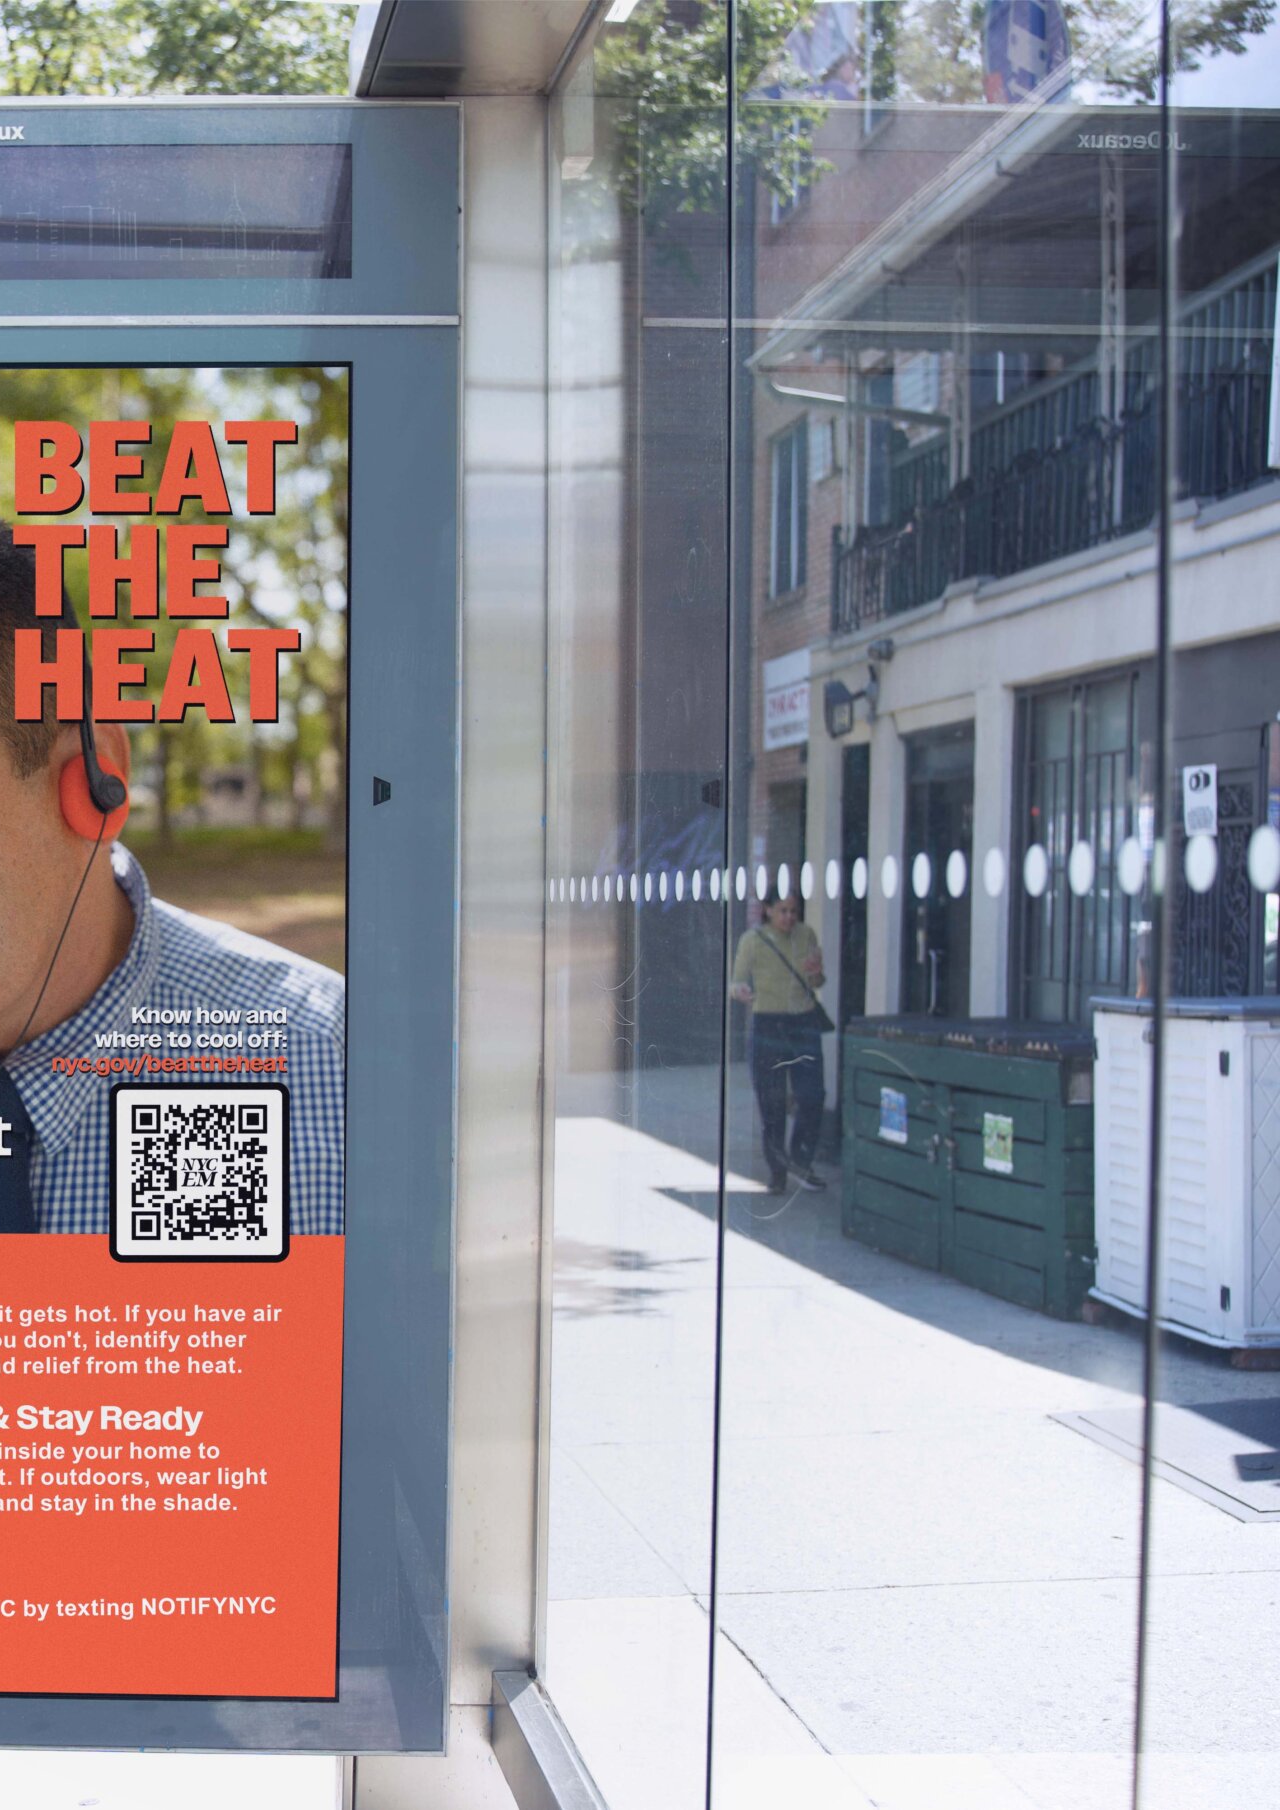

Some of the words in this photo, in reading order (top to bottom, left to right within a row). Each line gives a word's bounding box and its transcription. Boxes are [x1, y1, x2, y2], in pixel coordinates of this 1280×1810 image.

[14, 421, 298, 515] BEAT
[12, 525, 229, 619] THE
[14, 629, 301, 723] HEAT
[131, 1006, 192, 1025] Know
[196, 1006, 241, 1025] how
[246, 1006, 287, 1025] and
[95, 1031, 162, 1049] where
[167, 1031, 191, 1049] to
[196, 1031, 242, 1049] cool
[248, 1031, 288, 1049] off:
[52, 1054, 288, 1076] nyc.gov/beattheheat
[181, 1157, 218, 1172] NYC
[181, 1172, 218, 1187] EM
[19, 1305, 68, 1327] gets
[75, 1304, 117, 1323] hot.
[125, 1304, 140, 1322] If
[145, 1308, 186, 1327] you
[194, 1304, 246, 1322] have
[253, 1304, 282, 1322] air
[23, 1330, 88, 1351] don't,
[95, 1330, 181, 1353] identify
[187, 1330, 247, 1348] other
[23, 1356, 81, 1375] relief
[85, 1356, 138, 1374] from
[144, 1356, 181, 1374] the
[187, 1356, 242, 1374] heat.
[16, 1404, 94, 1436] Stay
[100, 1405, 204, 1437] Ready
[71, 1446, 124, 1464] your
[129, 1441, 192, 1460] home
[197, 1442, 220, 1460] to
[20, 1467, 35, 1486] If
[40, 1467, 150, 1488] outdoors,
[156, 1471, 211, 1486] wear
[217, 1467, 268, 1490] light
[40, 1494, 88, 1516] stay
[94, 1493, 114, 1511] in
[121, 1493, 157, 1512] the
[163, 1493, 238, 1511] shade.
[23, 1599, 50, 1622] by
[55, 1598, 134, 1621] texting
[141, 1596, 276, 1616] NOTIFYNYC
